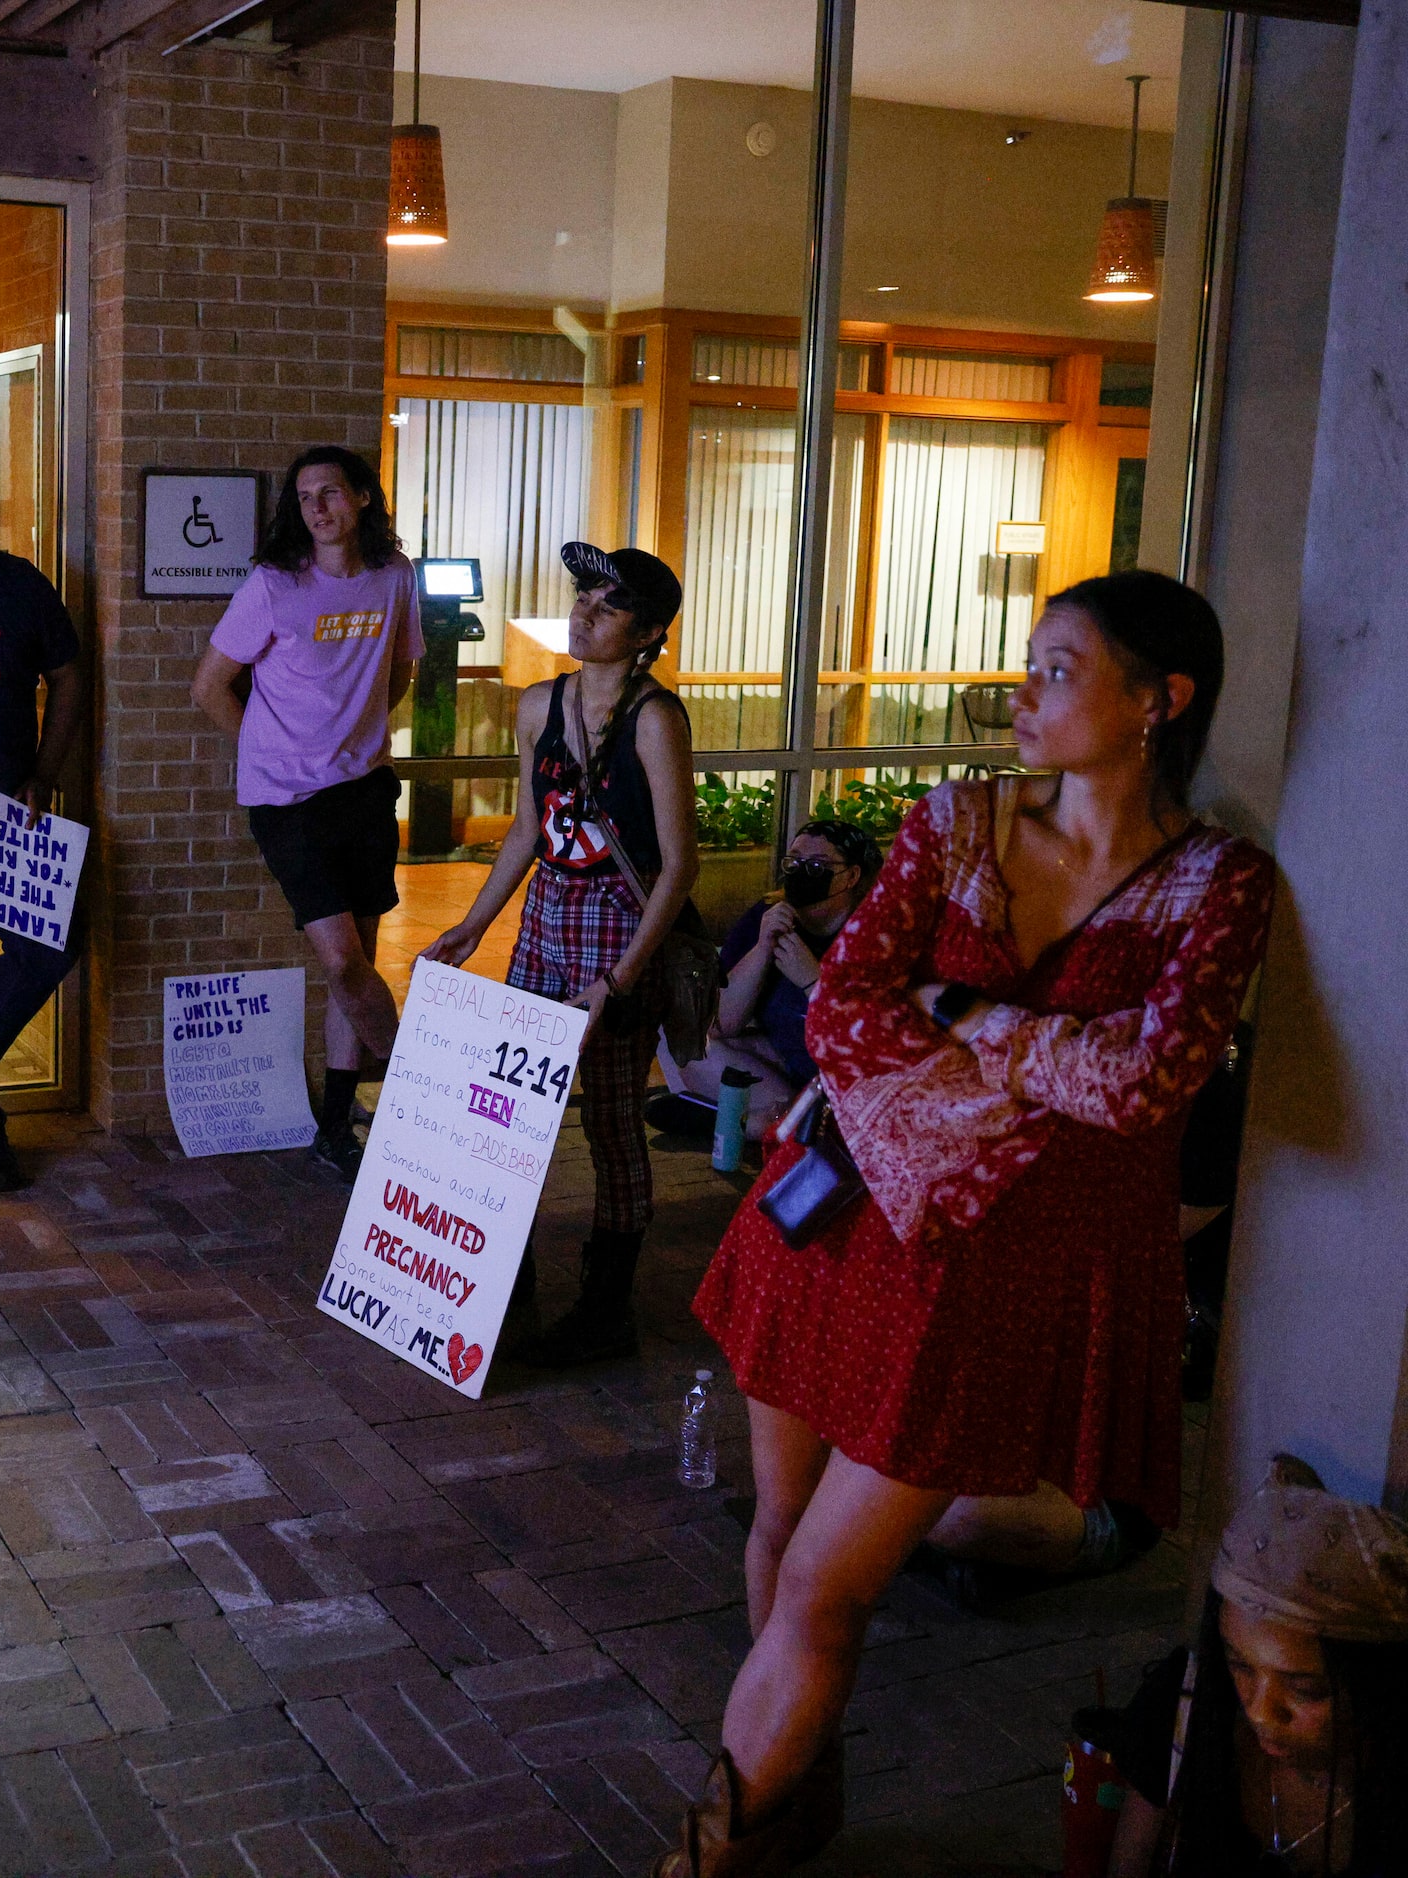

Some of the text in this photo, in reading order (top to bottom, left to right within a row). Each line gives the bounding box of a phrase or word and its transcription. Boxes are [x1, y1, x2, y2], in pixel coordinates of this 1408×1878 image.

[152, 567, 249, 577] ACCESSIBLE ENTRY
[320, 617, 340, 628] LET
[346, 625, 376, 638] SHT
[6, 803, 52, 836] MN
[20, 881, 56, 911] THE
[237, 993, 270, 1015] THE
[421, 972, 568, 1046] SERIAL RAPED
[173, 1019, 243, 1041] CHILD IS
[171, 1041, 232, 1064] LGBTQ
[415, 1014, 571, 1104] from ages 12-14
[169, 1055, 275, 1083] MENTALLY ILL
[169, 1080, 262, 1105] HOMELESS
[390, 1055, 554, 1144] Imagine a TEEN forced
[175, 1101, 265, 1123] STARVING
[182, 1118, 256, 1139] OF COLOR
[389, 1096, 547, 1178] to bear her DAD'S BABY
[187, 1138, 215, 1155] AN
[382, 1141, 507, 1214] Somehow avoided
[383, 1179, 486, 1255] UNWANTED
[363, 1223, 477, 1308] PREGNANCY
[335, 1244, 454, 1330] Some won't be as
[321, 1273, 391, 1330] LUCKY
[383, 1314, 410, 1345] AS
